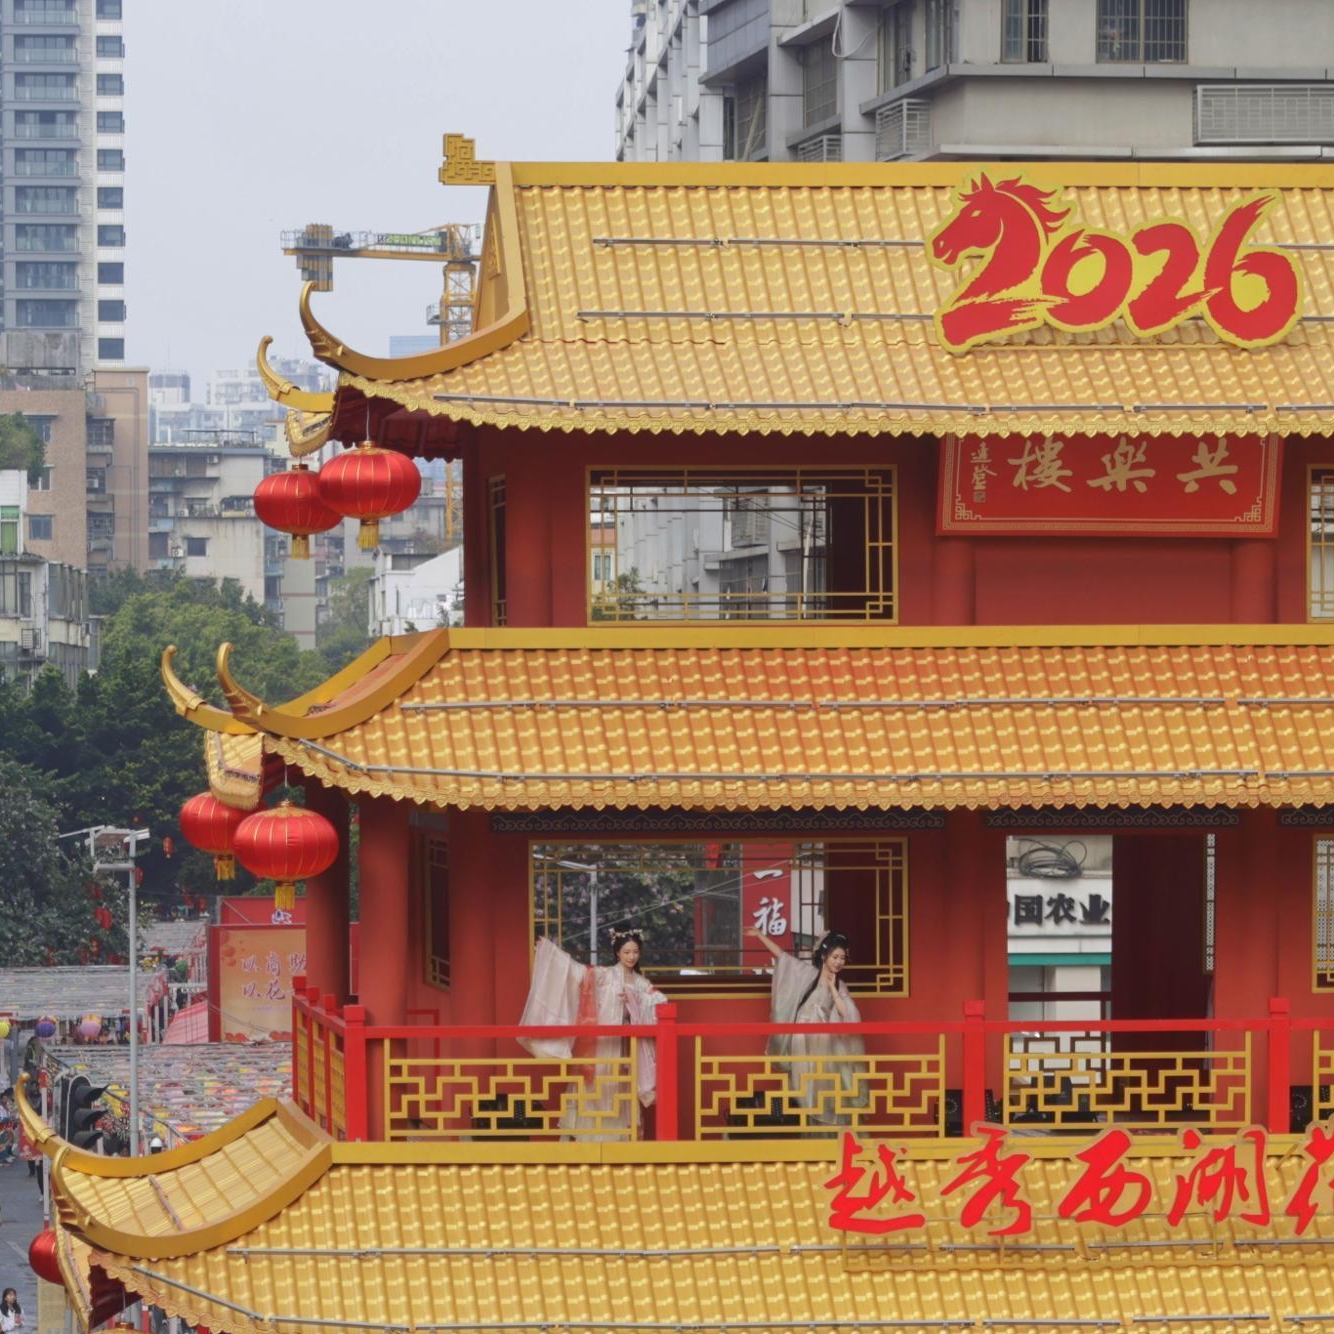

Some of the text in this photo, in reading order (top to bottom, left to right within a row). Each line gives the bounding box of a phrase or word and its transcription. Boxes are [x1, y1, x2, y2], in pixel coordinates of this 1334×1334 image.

[931, 171, 1300, 344] 2026
[1007, 893, 1110, 926] 国农业
